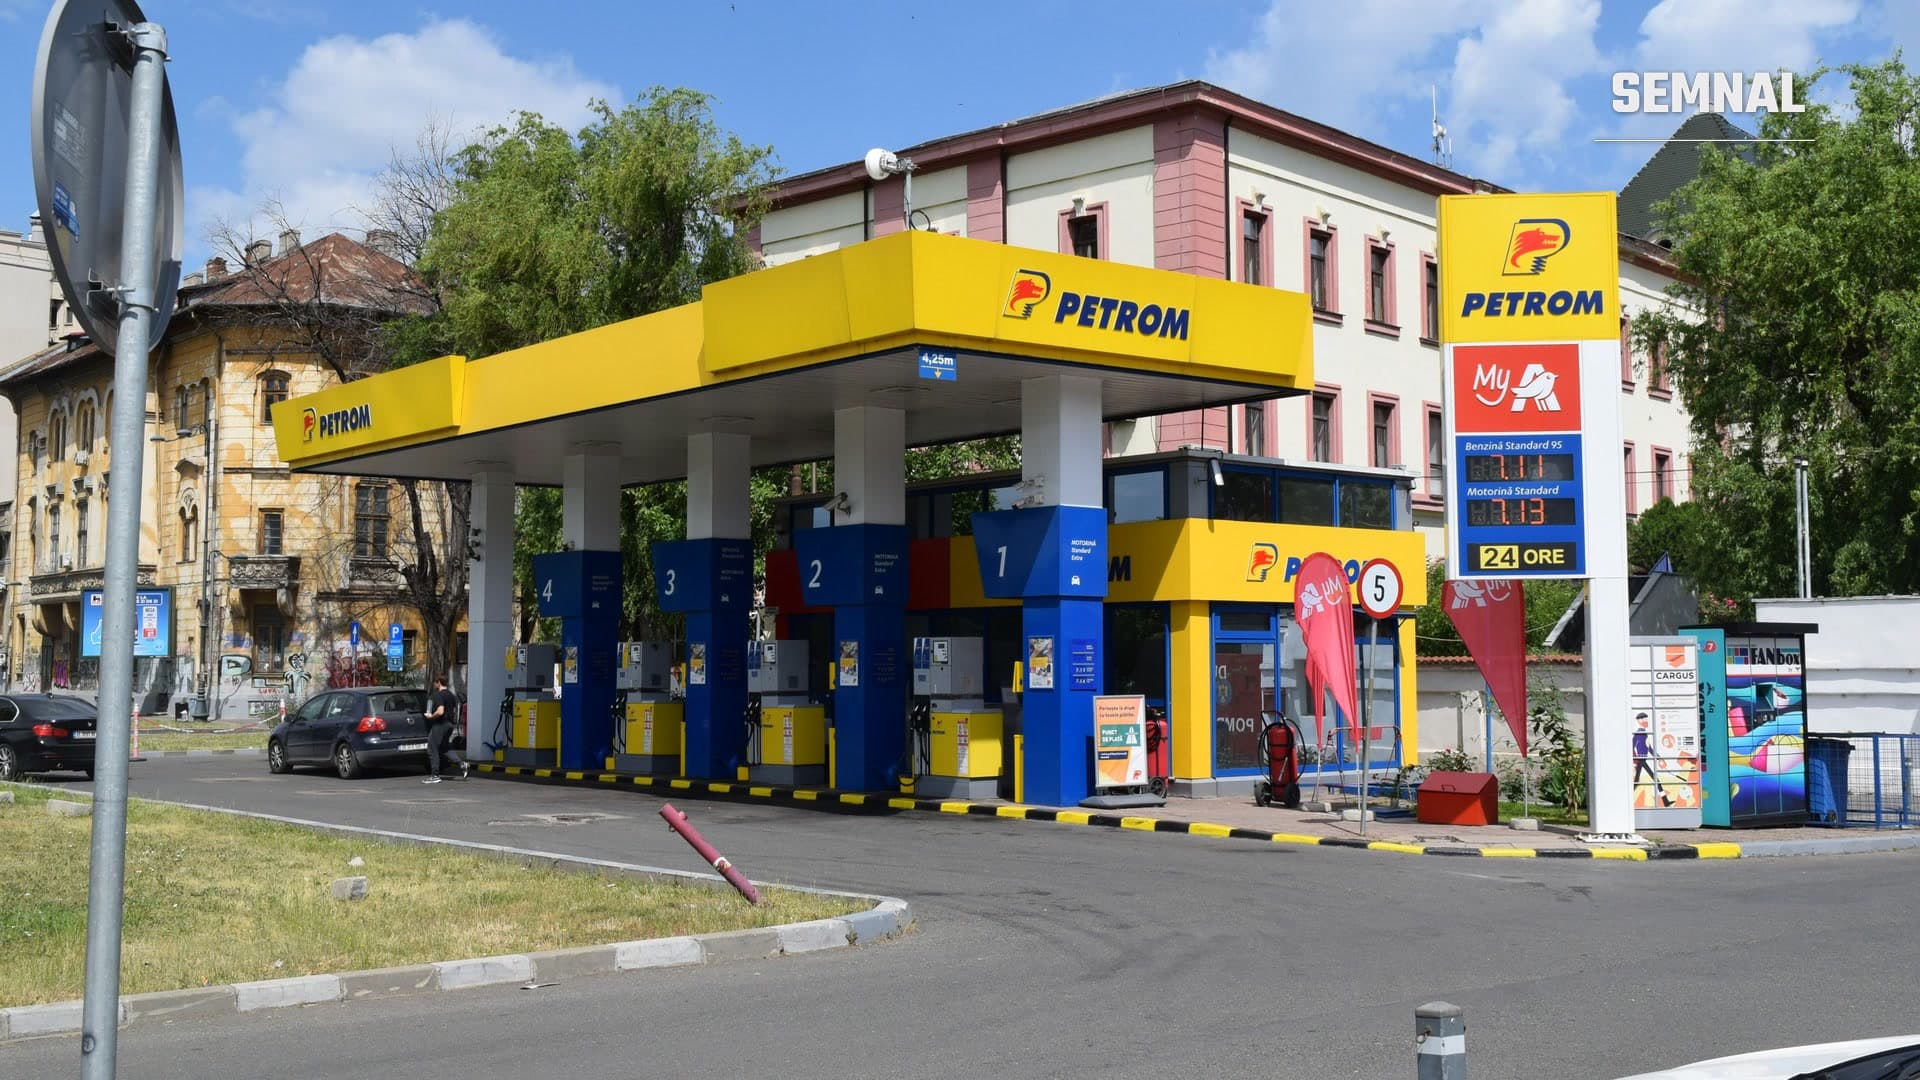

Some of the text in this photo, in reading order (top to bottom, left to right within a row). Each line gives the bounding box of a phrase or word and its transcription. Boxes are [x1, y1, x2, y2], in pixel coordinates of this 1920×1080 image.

[1055, 291, 1190, 341] PETROM
[1461, 290, 1603, 318] PETROM
[922, 353, 954, 366] 4,25m
[1472, 363, 1511, 406] My
[320, 403, 371, 438] PETROM
[1465, 440, 1562, 451] Benzină Standard 95
[1490, 454, 1543, 480] 7.11
[1467, 485, 1559, 496] Motorină Standard
[1491, 498, 1545, 525] 7.13
[998, 546, 1007, 577] 1
[1483, 547, 1565, 567] 24 ORE
[664, 569, 676, 596] 3
[808, 559, 822, 588] 2
[542, 579, 553, 602] 4
[1373, 575, 1386, 602] 5
[392, 626, 399, 638] P
[1656, 672, 1694, 680] CARGUS
[1708, 703, 1715, 713] by
